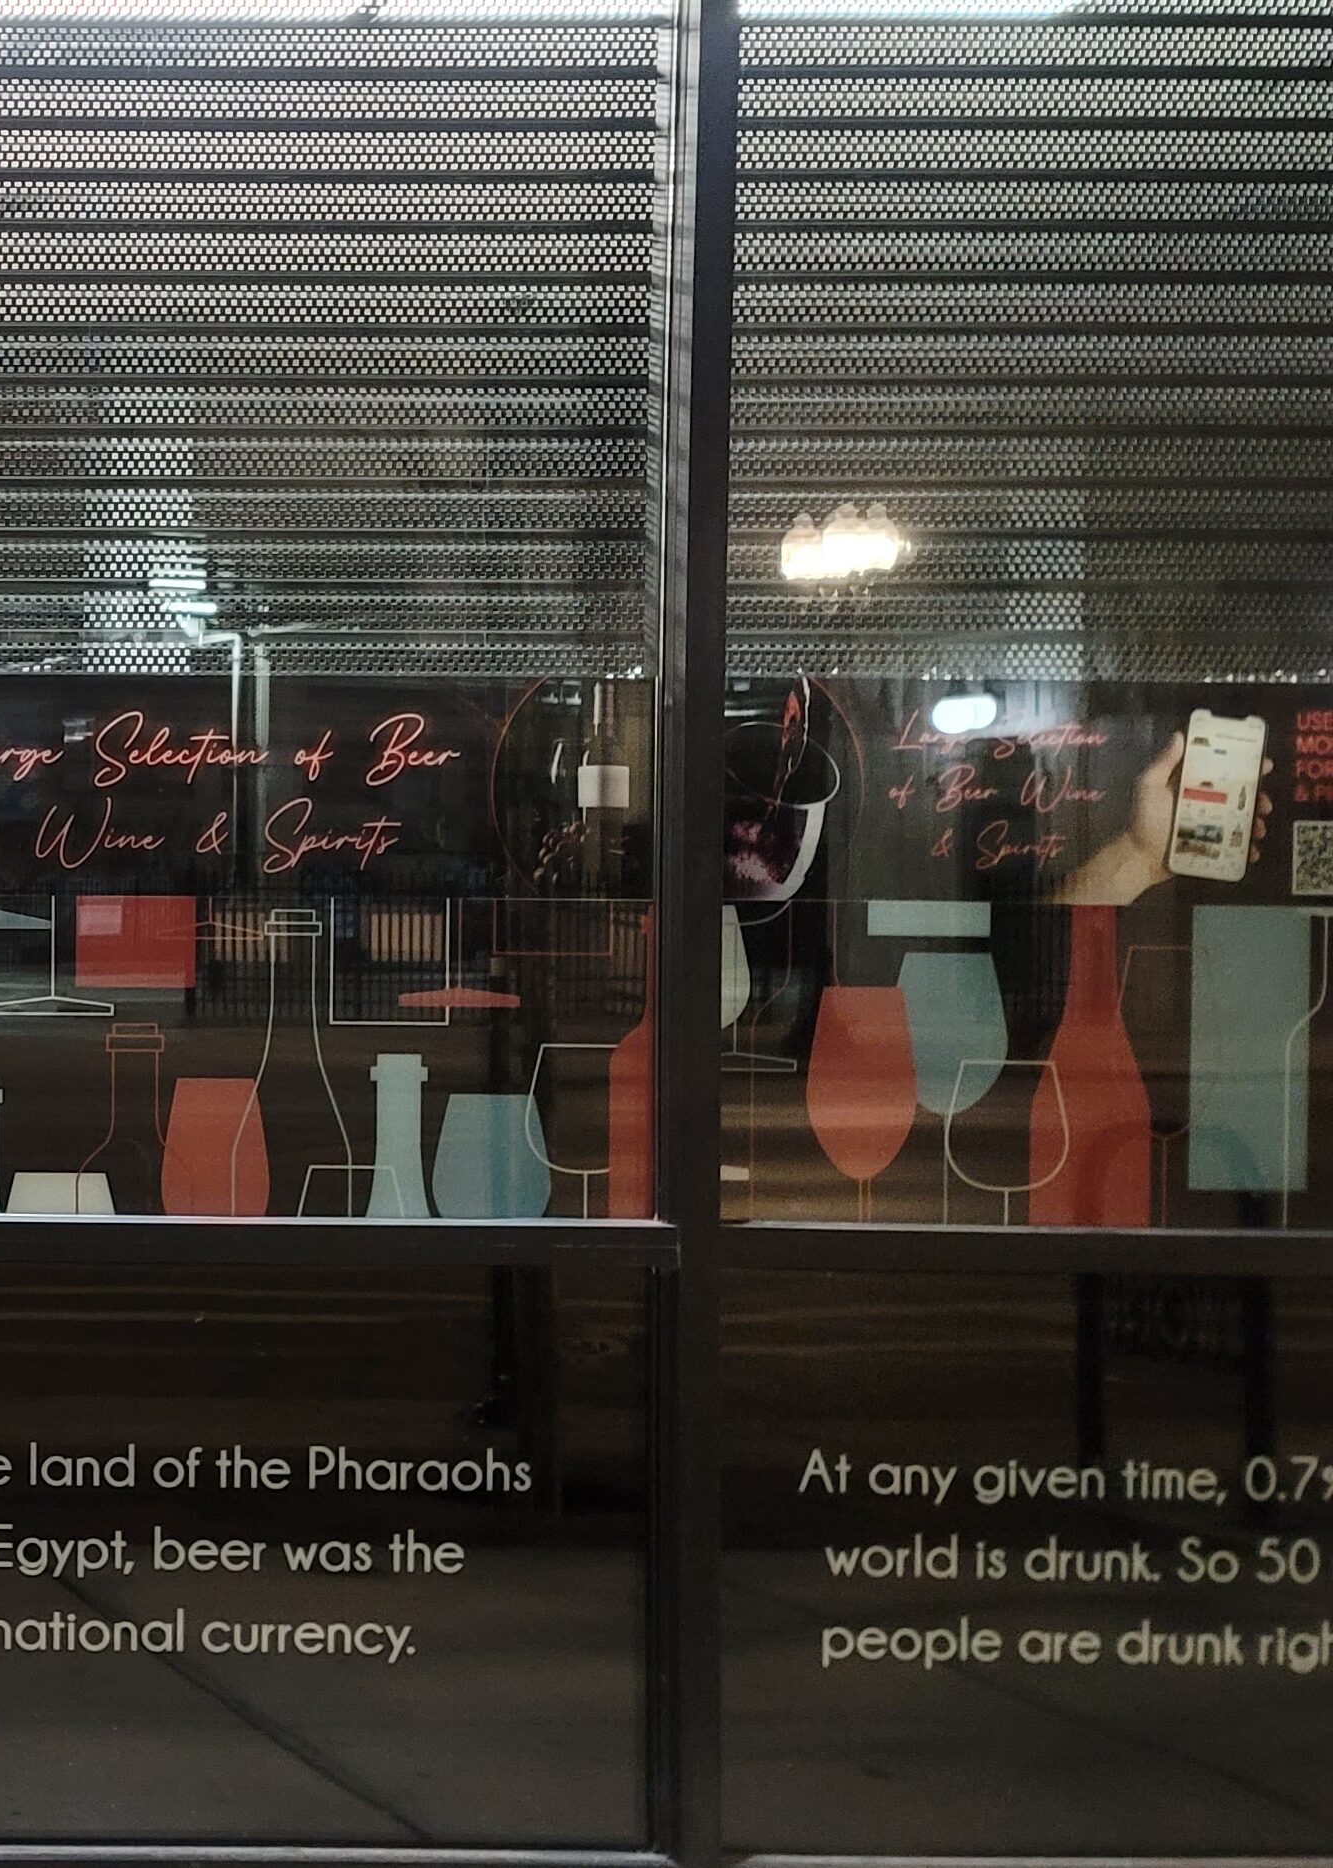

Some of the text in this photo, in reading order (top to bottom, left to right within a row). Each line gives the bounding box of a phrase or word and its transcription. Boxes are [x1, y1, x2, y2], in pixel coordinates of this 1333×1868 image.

[94, 710, 269, 787] Selection
[293, 730, 334, 782] of
[365, 712, 461, 787] Beer
[888, 762, 1107, 814] of Beer Wine
[35, 797, 402, 873] Wine & Spirits
[975, 819, 1066, 869] Spirits
[30, 1442, 135, 1488] land
[153, 1447, 203, 1490] of
[215, 1445, 291, 1490] the
[308, 1446, 533, 1493] Pharaohs
[798, 1448, 851, 1495] At
[868, 1462, 957, 1505] any
[973, 1459, 1106, 1505] given
[1123, 1459, 1228, 1505] time,
[153, 1526, 266, 1572] beer
[283, 1539, 372, 1573] was
[388, 1529, 465, 1574] the
[825, 1533, 959, 1579] world
[976, 1541, 1007, 1580] is
[1024, 1536, 1161, 1583] drunk.
[1177, 1537, 1239, 1584] So
[1256, 1536, 1321, 1584] 50
[201, 1618, 417, 1663] currency.
[821, 1615, 1002, 1671] people
[1018, 1628, 1101, 1664] are
[1117, 1620, 1244, 1667] drunk
